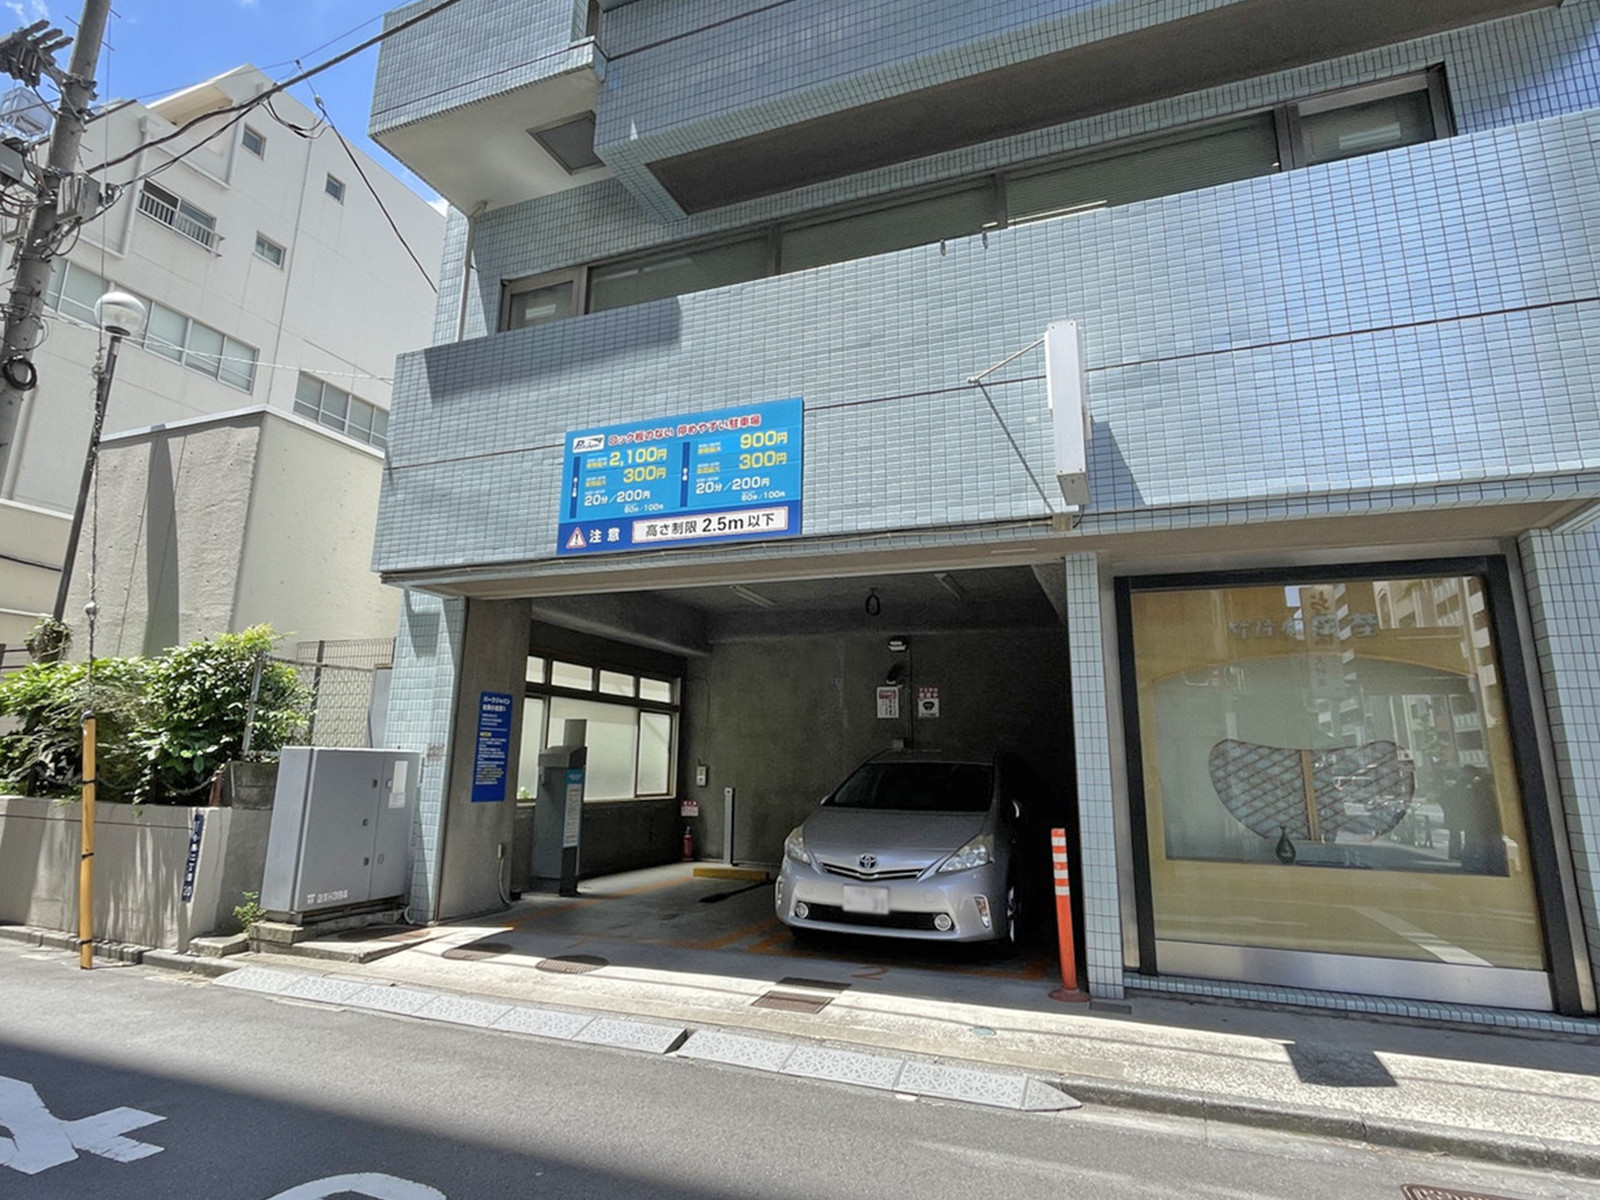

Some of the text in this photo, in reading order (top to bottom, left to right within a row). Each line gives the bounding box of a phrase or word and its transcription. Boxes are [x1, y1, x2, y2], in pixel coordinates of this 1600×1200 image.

[608, 428, 674, 446] ロック板のない
[740, 430, 788, 449] 900円
[609, 447, 667, 467] 2,100円
[739, 451, 787, 470] 300円
[623, 467, 666, 483] 300円
[589, 528, 620, 543] 注意
